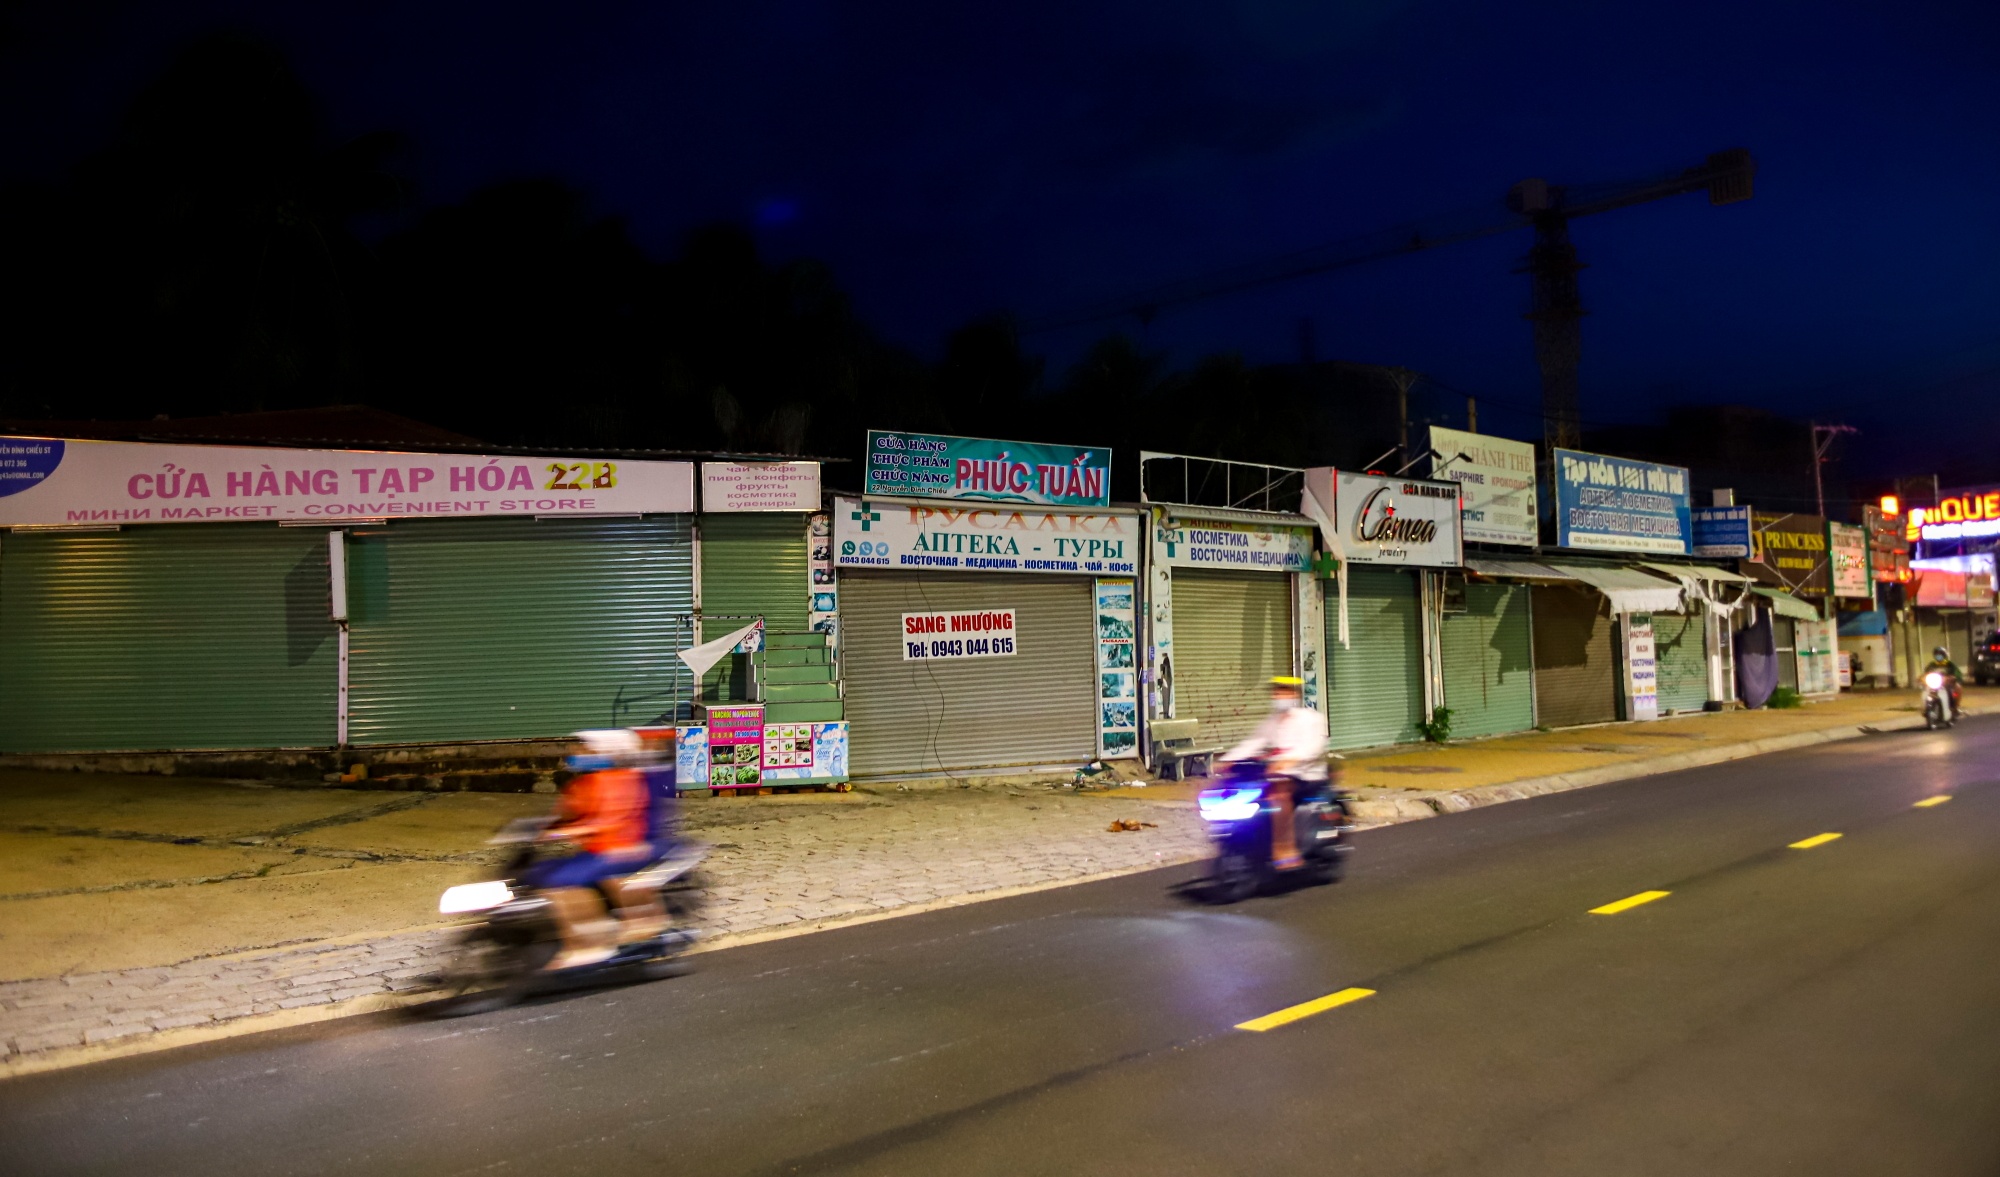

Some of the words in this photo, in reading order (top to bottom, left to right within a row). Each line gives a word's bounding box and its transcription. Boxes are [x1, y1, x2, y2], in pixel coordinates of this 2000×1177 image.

[877, 434, 905, 449] CỬA
[908, 436, 947, 452] HÀNG
[872, 453, 909, 468] THỰC
[912, 453, 950, 468] PHẨM
[127, 462, 210, 500] CỬA
[226, 464, 339, 497] HÀNG
[352, 466, 434, 499] TẠP
[449, 458, 534, 492] HÓA
[543, 462, 618, 491] 22B
[754, 474, 815, 482] конфеты
[871, 468, 909, 482] CHỨC
[912, 471, 950, 484] NĂNG
[955, 450, 1034, 494] PHÚC
[1037, 451, 1104, 498] TUẤN
[1449, 470, 1484, 485] SAPPHIRE
[727, 491, 797, 499] косметика
[1580, 486, 1617, 508] АПТЕКА
[1621, 491, 1674, 514] КОСМЕТИКА
[304, 500, 490, 517] CONVENIENT
[499, 498, 596, 511] STORE
[906, 505, 1129, 535] РУСАЛКА
[1569, 508, 1630, 532] ВОСТОЧНАЯ
[1630, 514, 1682, 537] МЕДИЦИНА
[912, 531, 1021, 556] АПТЕКА
[1053, 537, 1125, 559] ТУРЫ
[1190, 530, 1249, 547] КОСМЕТИКА
[1765, 532, 1825, 550] PRINCESS
[840, 556, 860, 564] 0943
[860, 556, 875, 564] 044
[900, 554, 958, 567] ВОСТОЧНАЯ
[965, 557, 1018, 569] МЕДИЦИНА
[1025, 559, 1078, 571] КОСМЕТИКА
[1084, 560, 1102, 571] ЧАЙ
[1109, 561, 1134, 572] КОФЕ
[1190, 547, 1248, 564] ВОСТОЧНАЯ
[1250, 551, 1300, 566] МЕДИЦИНА
[905, 616, 946, 634] SANG
[951, 611, 1013, 634] NHƯỢNG
[907, 641, 928, 658] Tel:
[931, 640, 962, 657] 0943
[966, 638, 989, 655] 044
[992, 637, 1013, 653] 615
